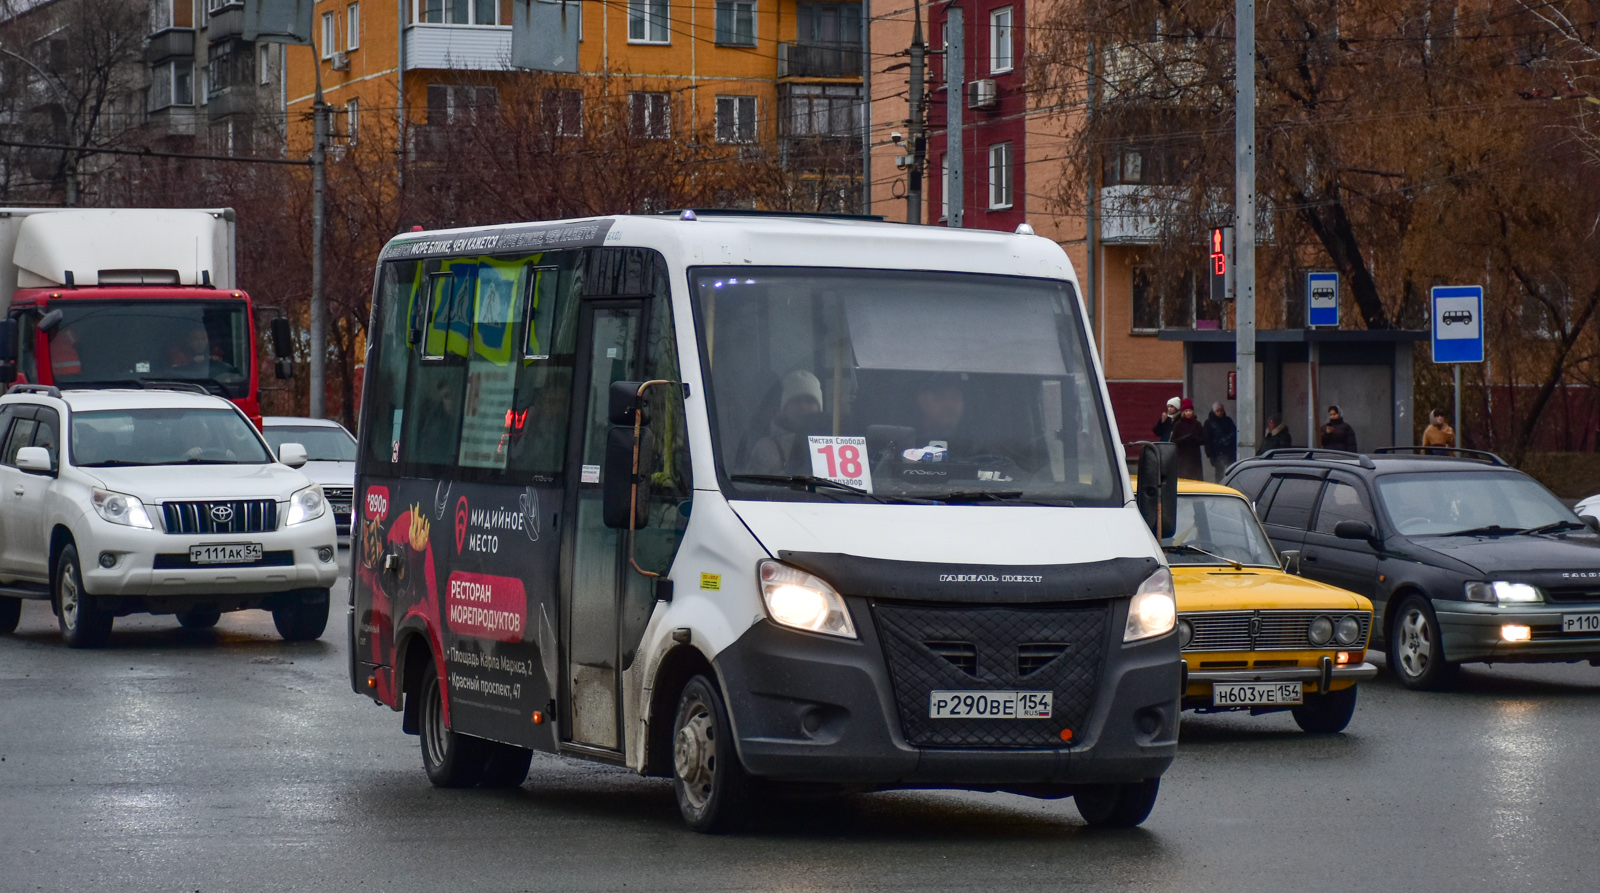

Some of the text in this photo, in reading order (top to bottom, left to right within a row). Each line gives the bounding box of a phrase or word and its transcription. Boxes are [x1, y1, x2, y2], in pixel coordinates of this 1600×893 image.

[410, 241, 429, 254] МОРЕ
[428, 239, 453, 254] БЛИЖЕ,
[453, 238, 467, 252] ЧЕМ
[465, 235, 500, 251] КАЖЕТСЯ
[808, 437, 866, 446] Чистая Слобода
[817, 444, 863, 479] 18
[470, 506, 524, 530] МИДИЙНОЕ
[195, 545, 258, 560] Р111АК 54
[469, 533, 499, 554] МЕСТО
[939, 574, 999, 582] ГАЗЕЛЬ
[451, 580, 492, 603] РЕСТОРАН
[450, 604, 521, 632] МОРЕПРОДУКТОВ
[1567, 615, 1599, 630] Р110
[450, 647, 533, 677] Площадь Карла Маркса, 2
[451, 672, 521, 700] Красный проспект, 47
[1219, 685, 1299, 703] Н603УЕ 154
[937, 694, 1048, 716] Р290ВЕ 154
